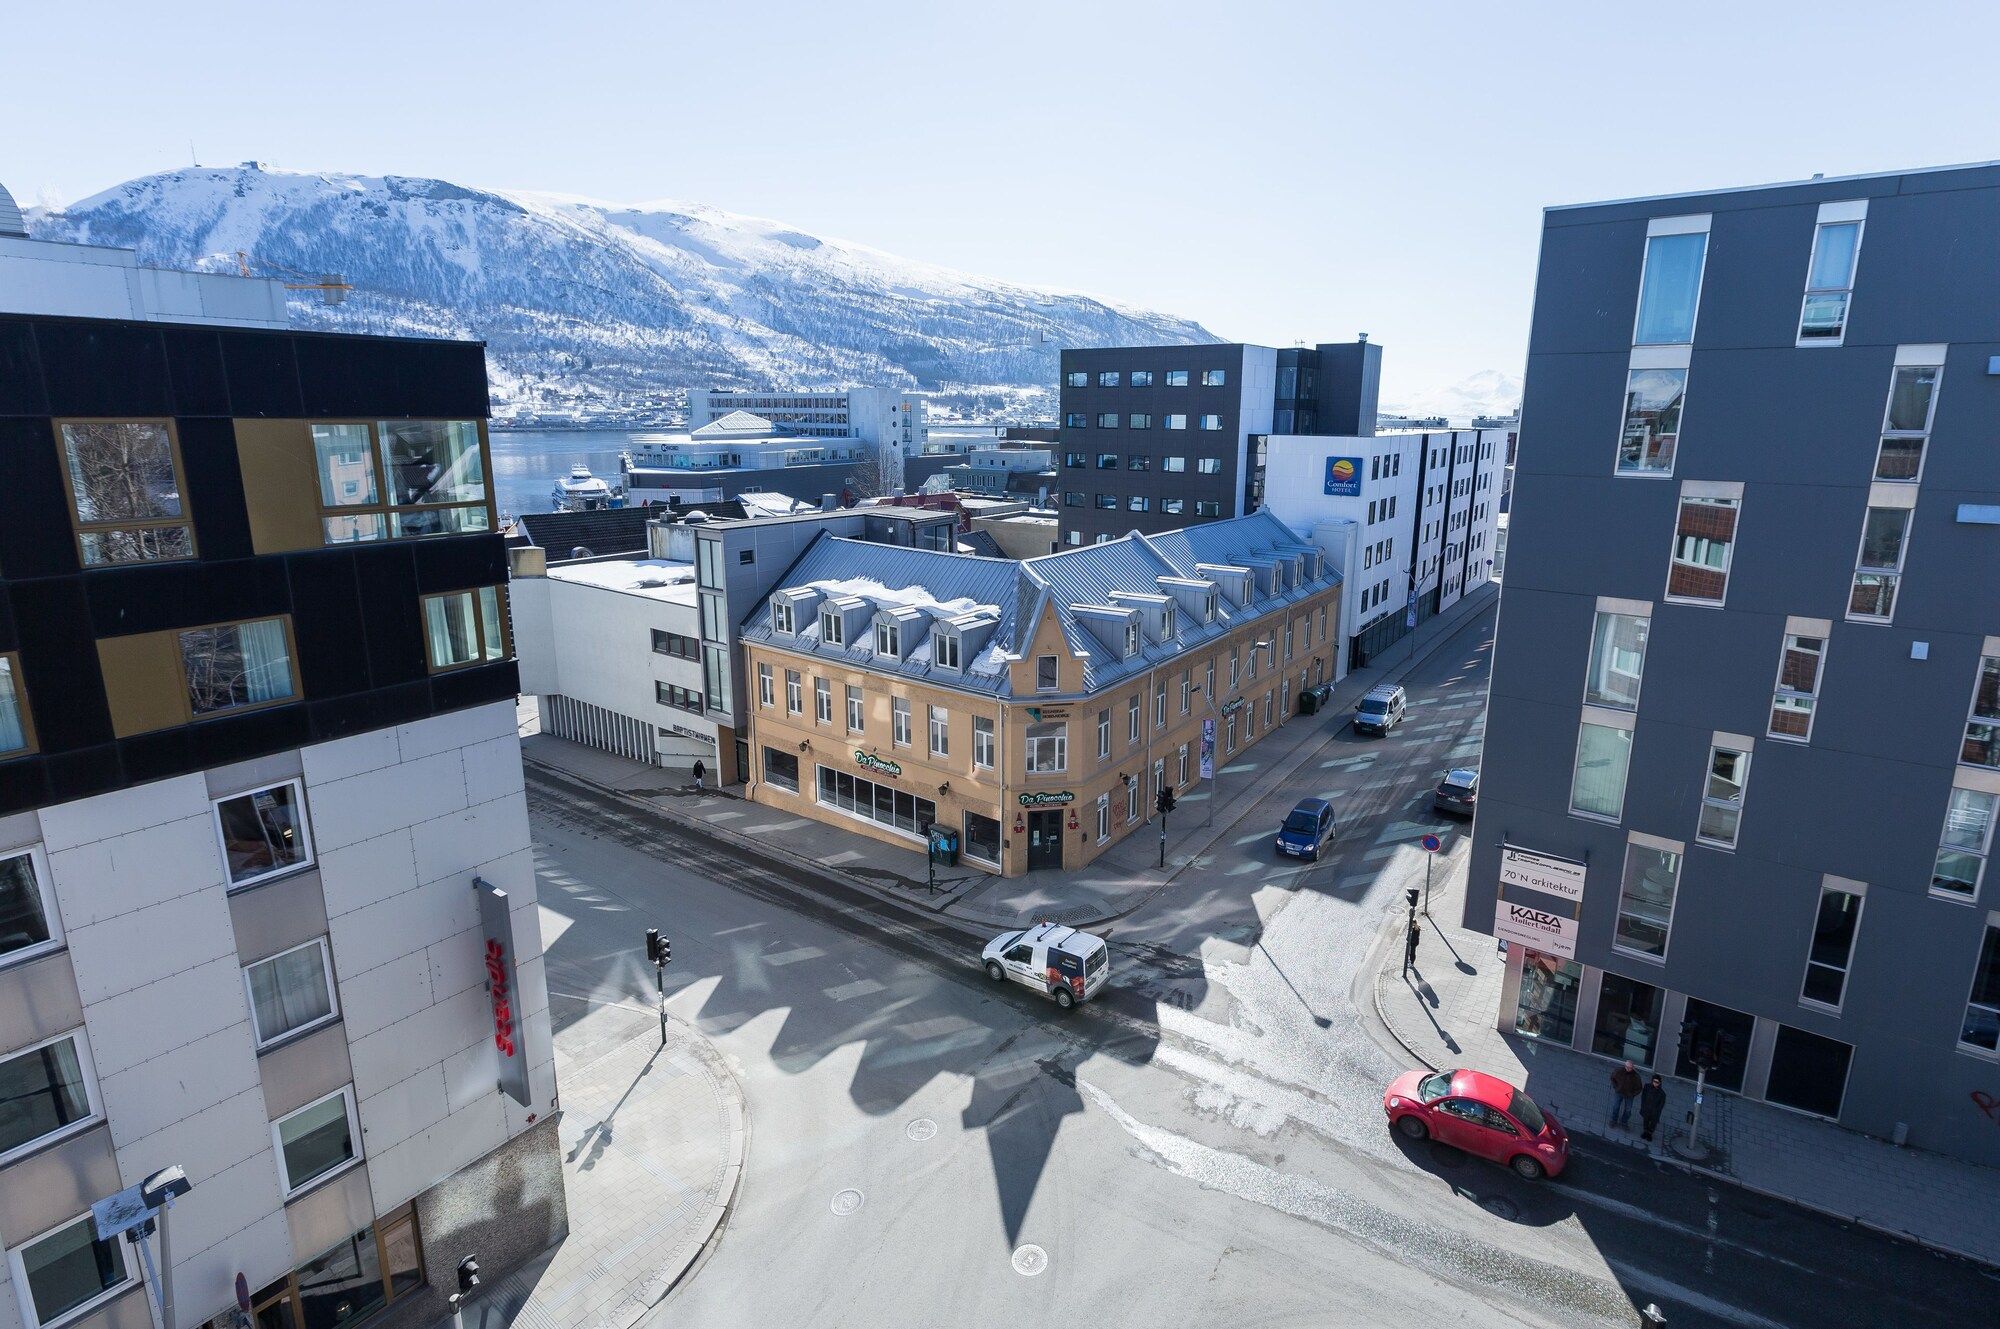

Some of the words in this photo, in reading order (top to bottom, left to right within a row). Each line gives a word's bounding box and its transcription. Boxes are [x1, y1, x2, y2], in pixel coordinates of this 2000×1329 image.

[1327, 480, 1358, 489] Comfort
[1020, 794, 1034, 804] Da
[1531, 878, 1578, 895] arkitektur
[1554, 942, 1572, 951] hjem
